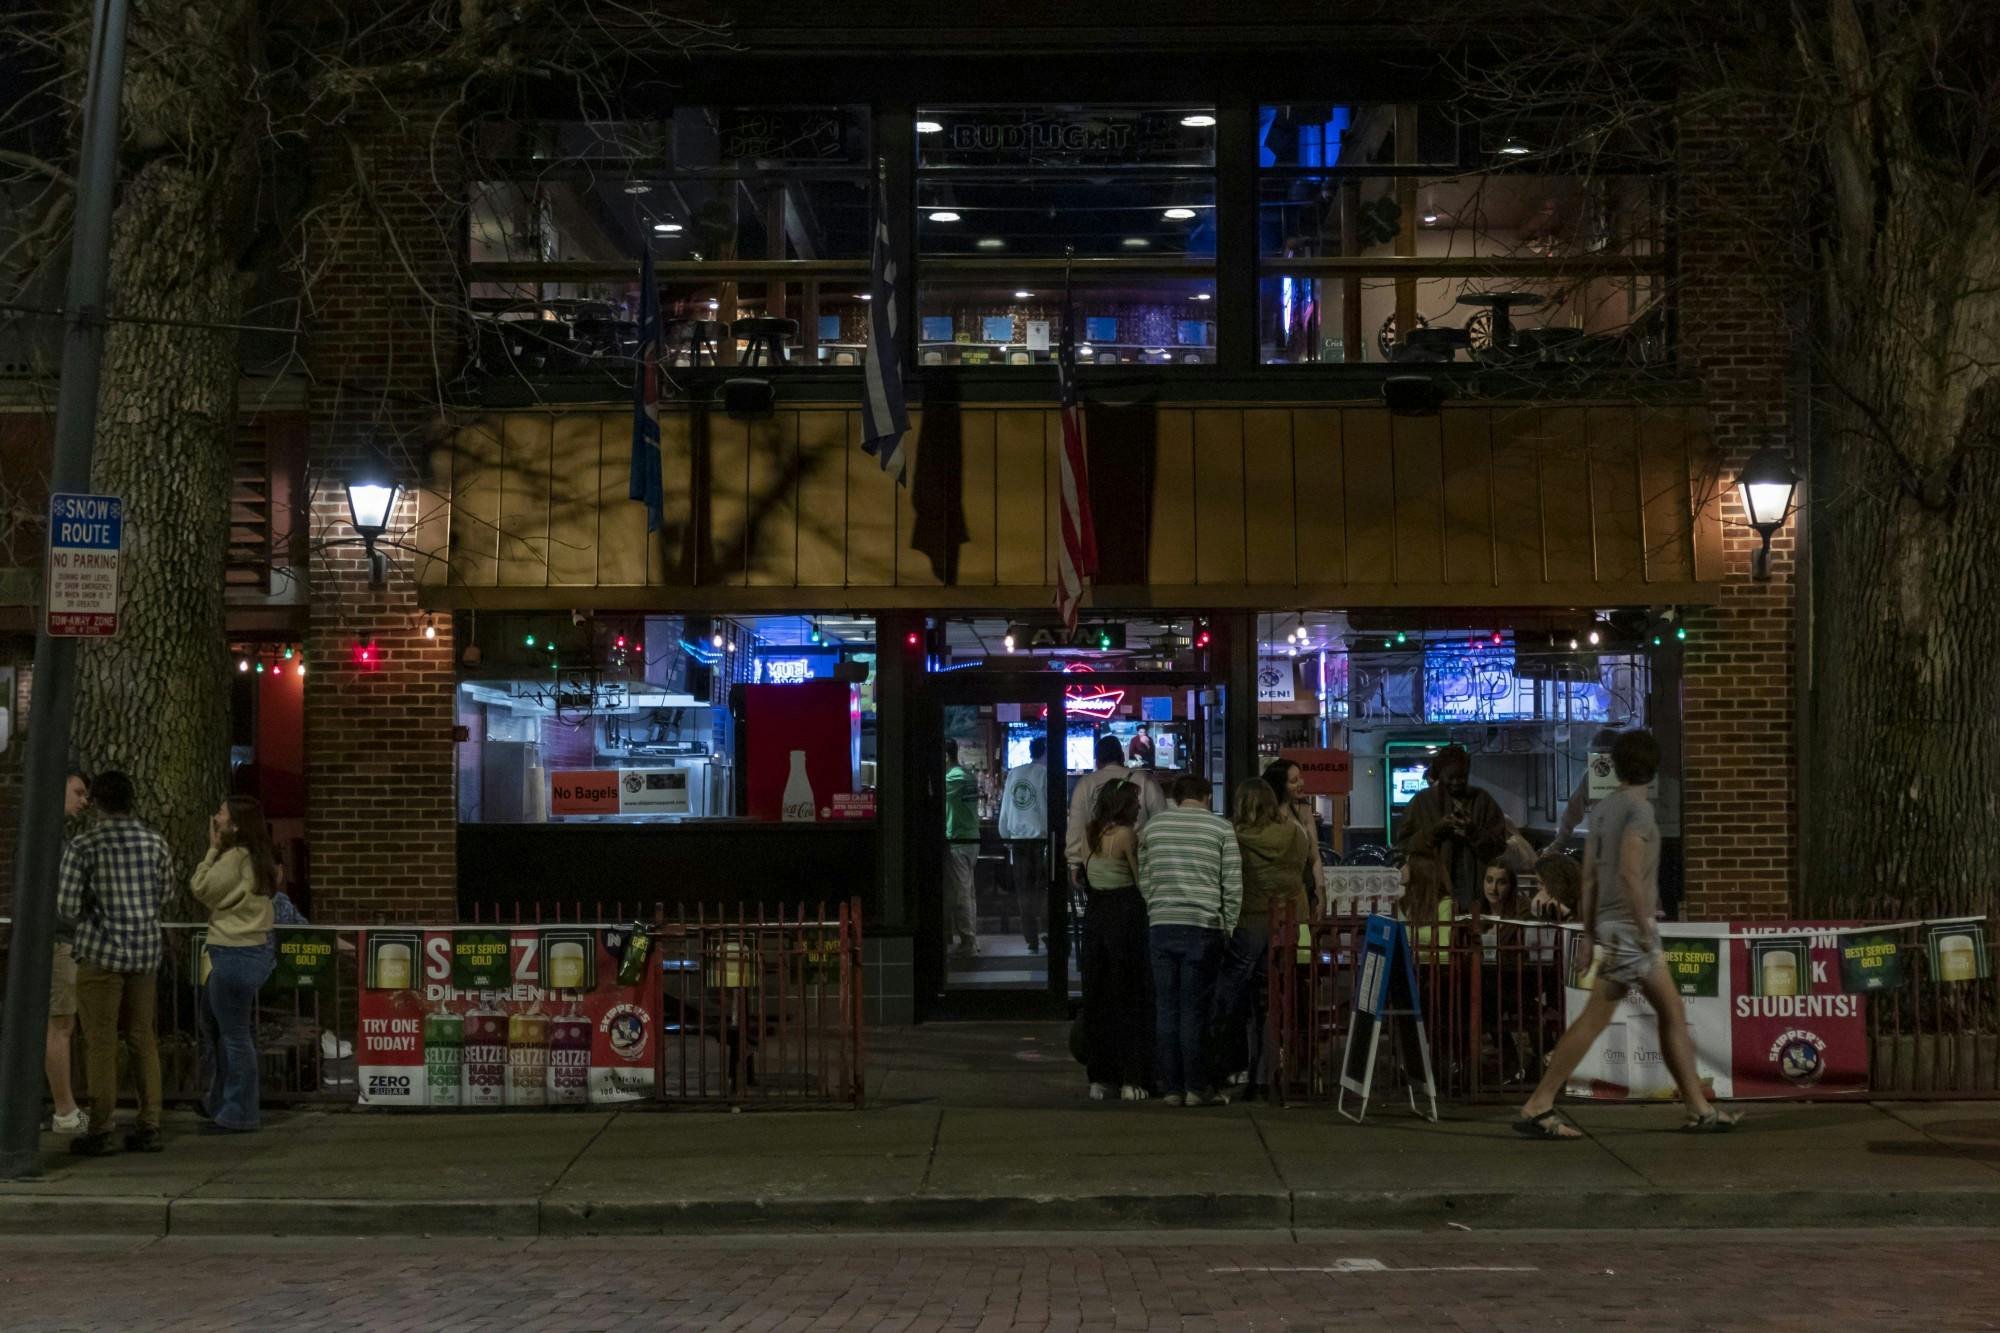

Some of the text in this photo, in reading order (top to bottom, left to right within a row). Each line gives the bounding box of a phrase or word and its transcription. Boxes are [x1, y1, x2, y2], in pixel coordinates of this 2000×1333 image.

[954, 123, 1131, 150] BUD LIGHT
[65, 499, 109, 520] SNOW
[61, 522, 111, 544] ROUTE
[53, 553, 116, 569] NO PARKING
[51, 615, 114, 626] TOW-AWAY ZONE
[1031, 627, 1101, 645] ATM
[1260, 690, 1290, 698] PEN!
[1302, 763, 1348, 772] BAGELS!
[554, 786, 618, 802] No Bagels
[281, 943, 332, 955] BEST SERVED
[456, 944, 507, 954] BEST SERVED
[1845, 944, 1897, 959] BEST SERVED
[296, 955, 316, 965] GOLD
[471, 955, 492, 966] GOLD
[1664, 951, 1715, 963] BEST SERVED
[1861, 957, 1883, 968] GOLD
[1679, 962, 1700, 974] GOLD
[1736, 995, 1857, 1017] STUDENTS!
[362, 1018, 420, 1033] TRY ONE
[365, 1036, 416, 1051] TODAY!
[1769, 1029, 1826, 1062] SKIPPER'S
[425, 1047, 464, 1063] SELTZE
[369, 1075, 410, 1087] ZERO
